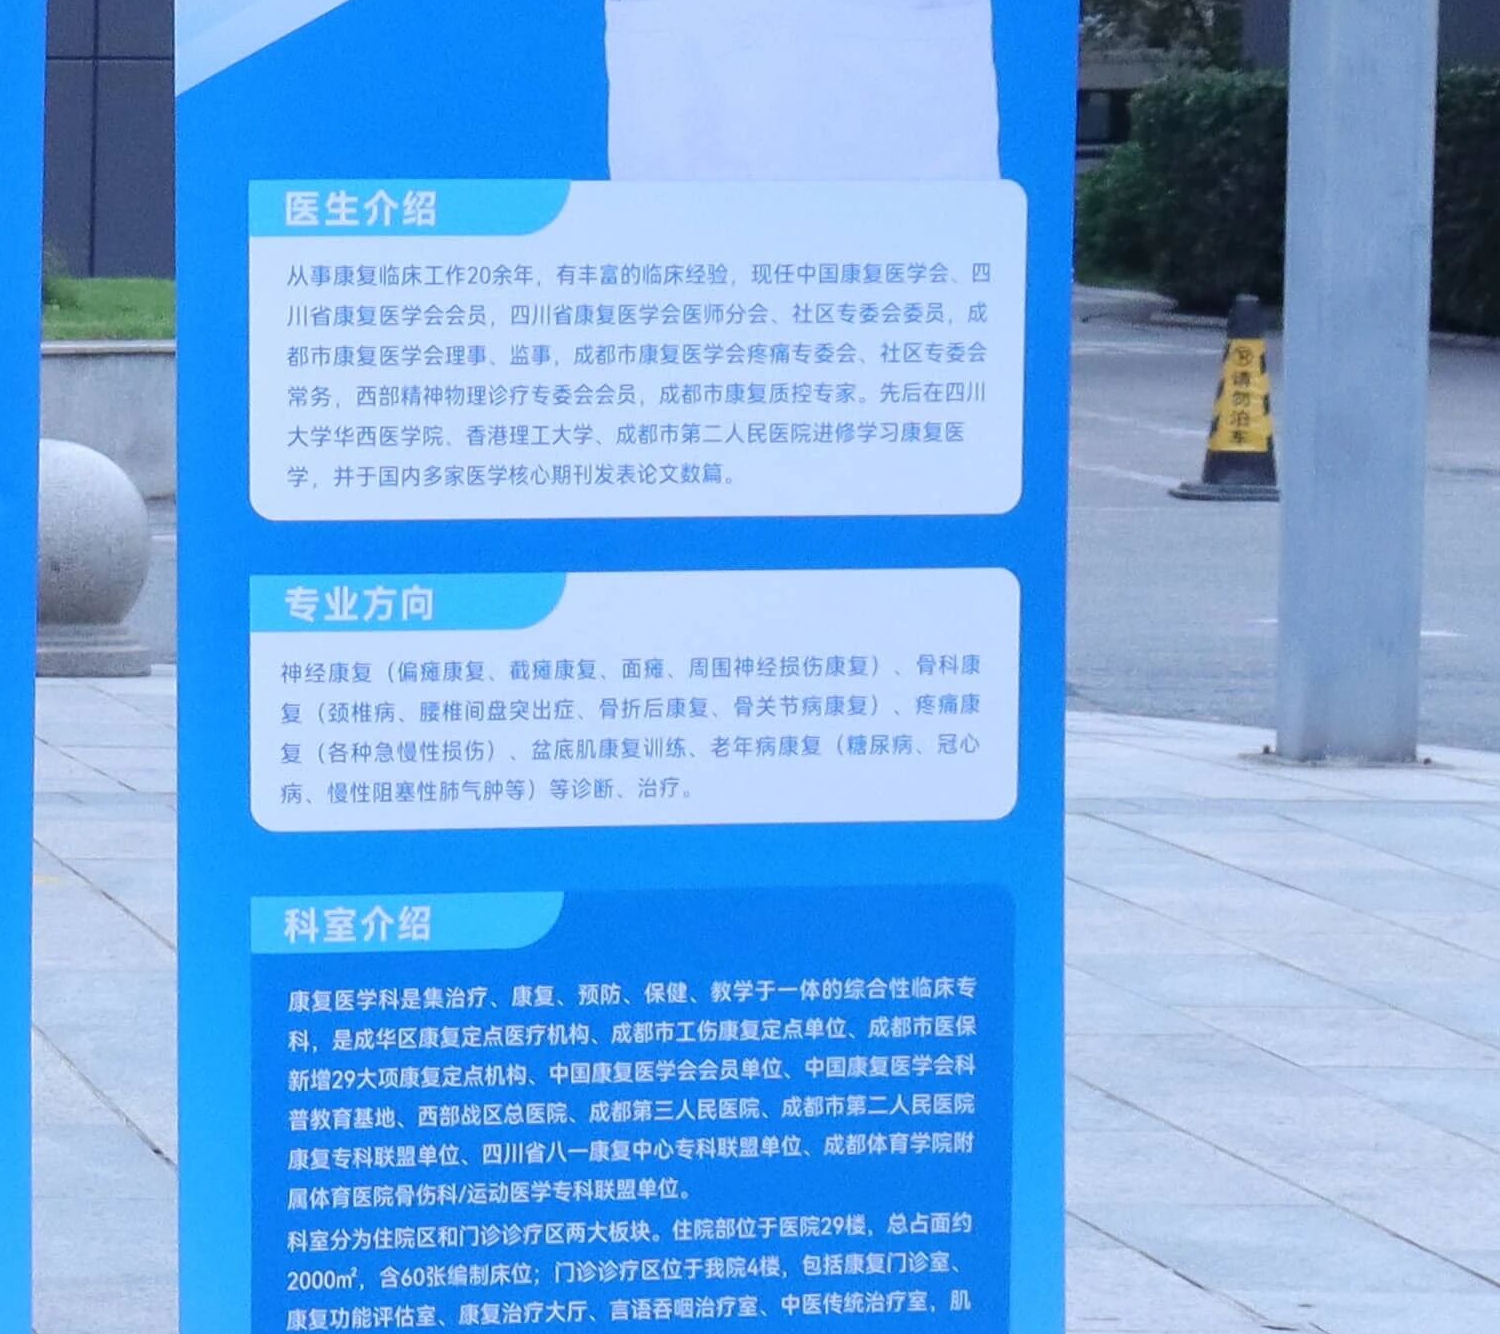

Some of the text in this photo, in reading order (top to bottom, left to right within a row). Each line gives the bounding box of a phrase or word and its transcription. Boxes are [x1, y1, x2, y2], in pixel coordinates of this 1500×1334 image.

[284, 190, 438, 227] 医生介绍
[284, 584, 435, 623] 专业方向
[284, 905, 432, 945] 科室介绍
